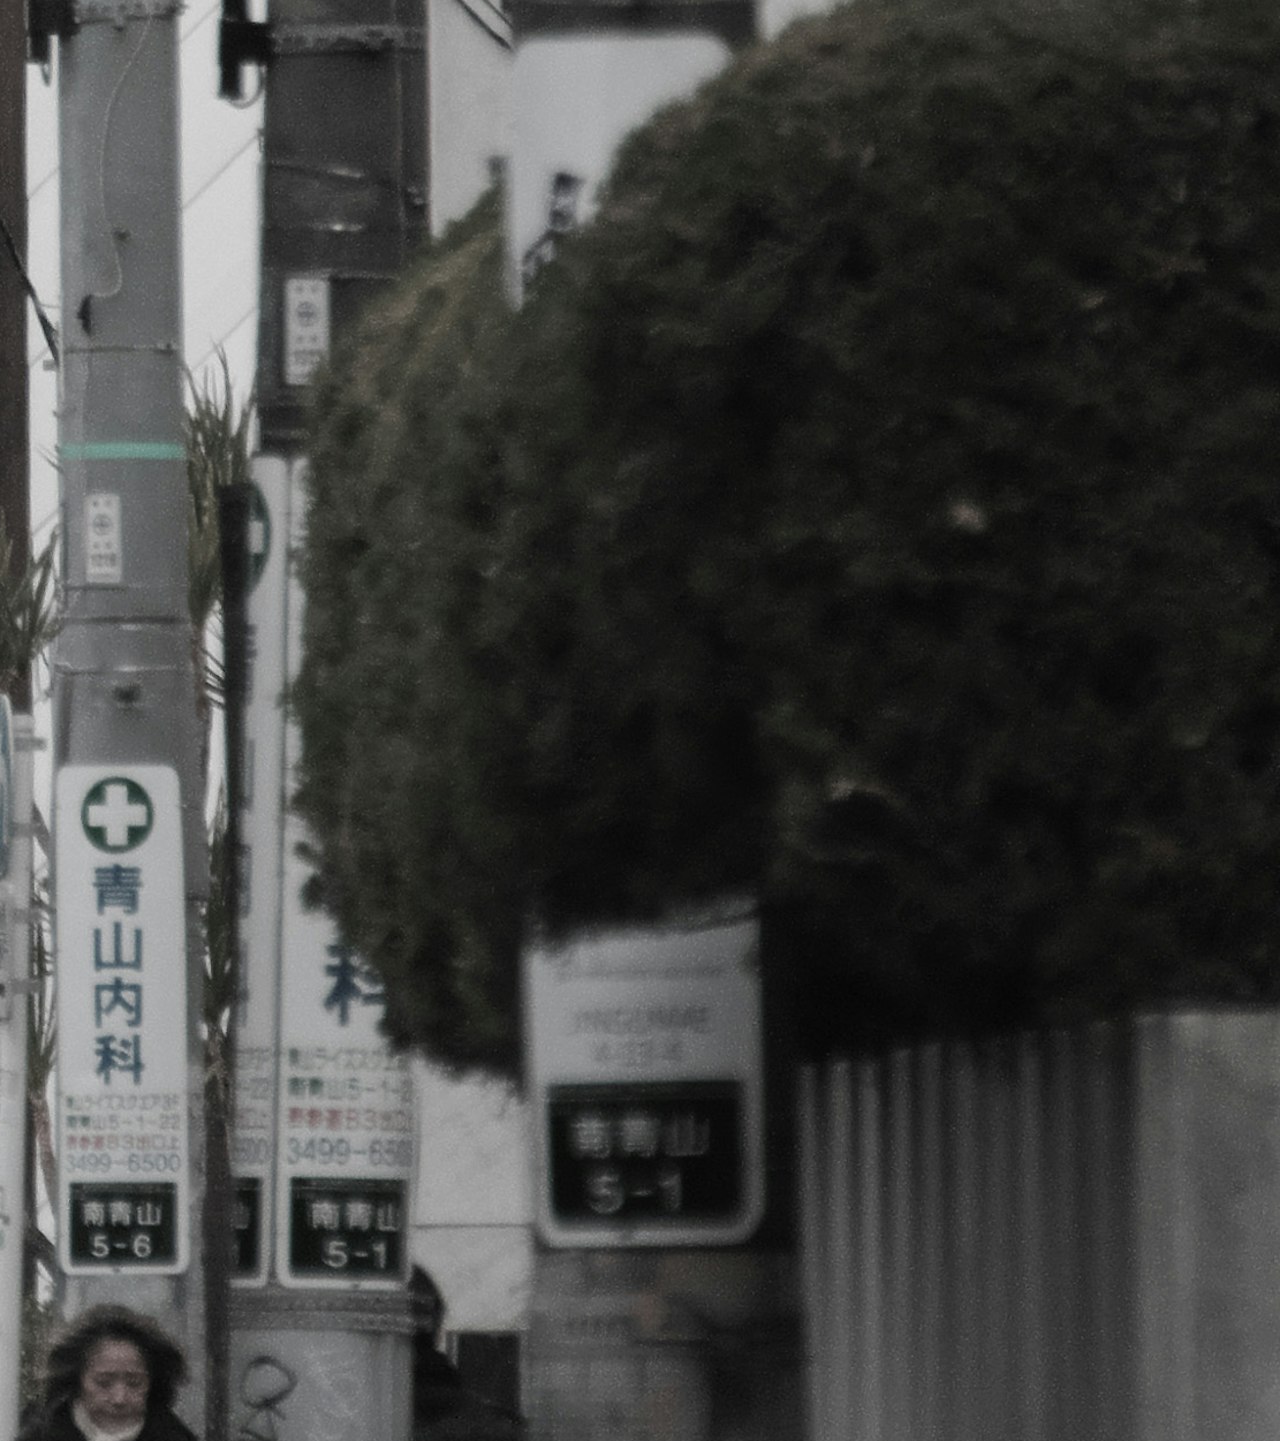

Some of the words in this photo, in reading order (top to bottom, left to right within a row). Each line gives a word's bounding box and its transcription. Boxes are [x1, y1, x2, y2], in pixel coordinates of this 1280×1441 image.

[92, 864, 145, 1086] 青山内科
[65, 1152, 181, 1173] 3499-6500
[586, 1172, 683, 1216] 5-1
[83, 1200, 162, 1227] 南青山
[310, 1202, 399, 1231] 南青山
[90, 1234, 152, 1258] 5-6
[322, 1240, 388, 1269] 5-1
